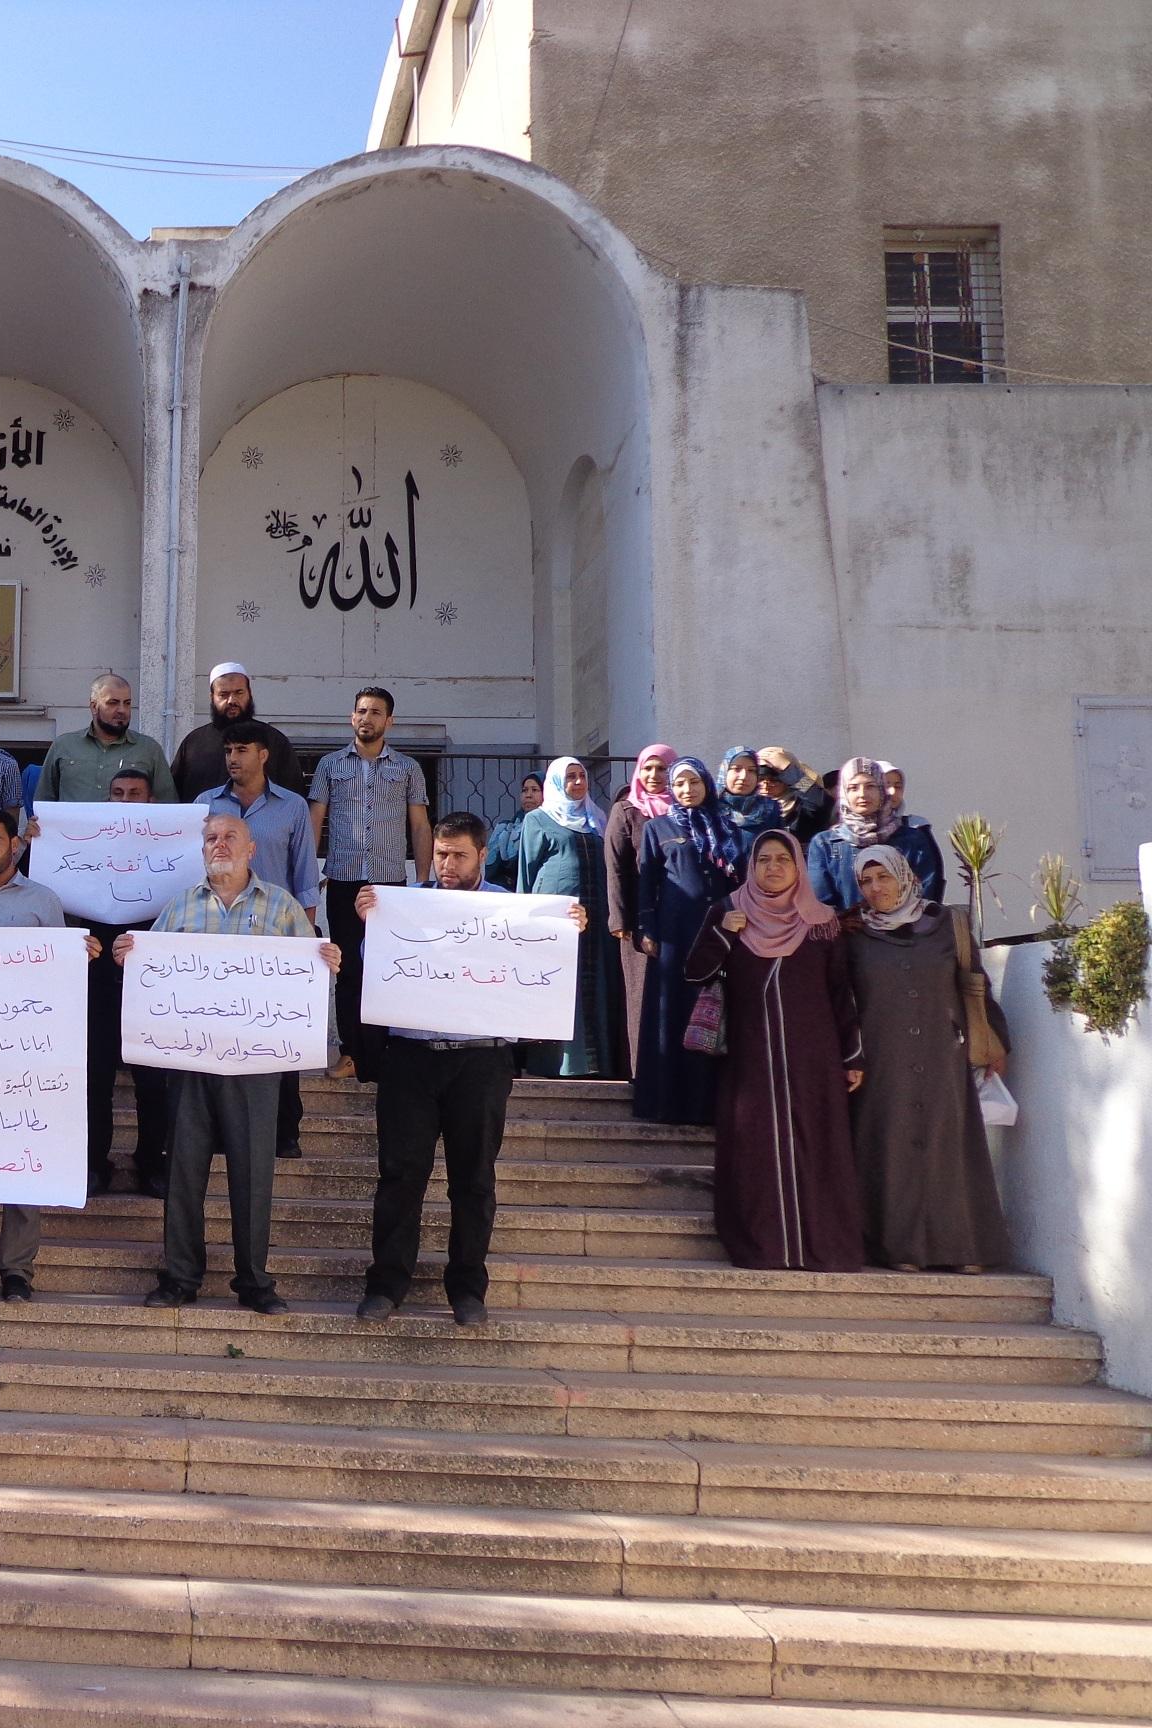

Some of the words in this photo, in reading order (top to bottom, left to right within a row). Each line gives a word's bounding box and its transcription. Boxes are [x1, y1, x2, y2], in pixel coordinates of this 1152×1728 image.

[61, 818, 132, 841] الرئيس
[135, 819, 182, 841] سيادة
[106, 853, 142, 872] ثقة
[145, 854, 184, 873] كلنا
[108, 882, 153, 902] لنا
[389, 916, 486, 944] الرئيس
[491, 918, 558, 946] سيادة
[3, 944, 55, 965] القائد
[139, 954, 210, 988] والتاريخ
[213, 956, 255, 981] للحق
[462, 964, 507, 984] ثقة
[512, 967, 562, 986] كلنا
[149, 991, 252, 1020] الشخصيات
[140, 1028, 214, 1058] الوطنية
[0, 1109, 48, 1131] مطالبنا
